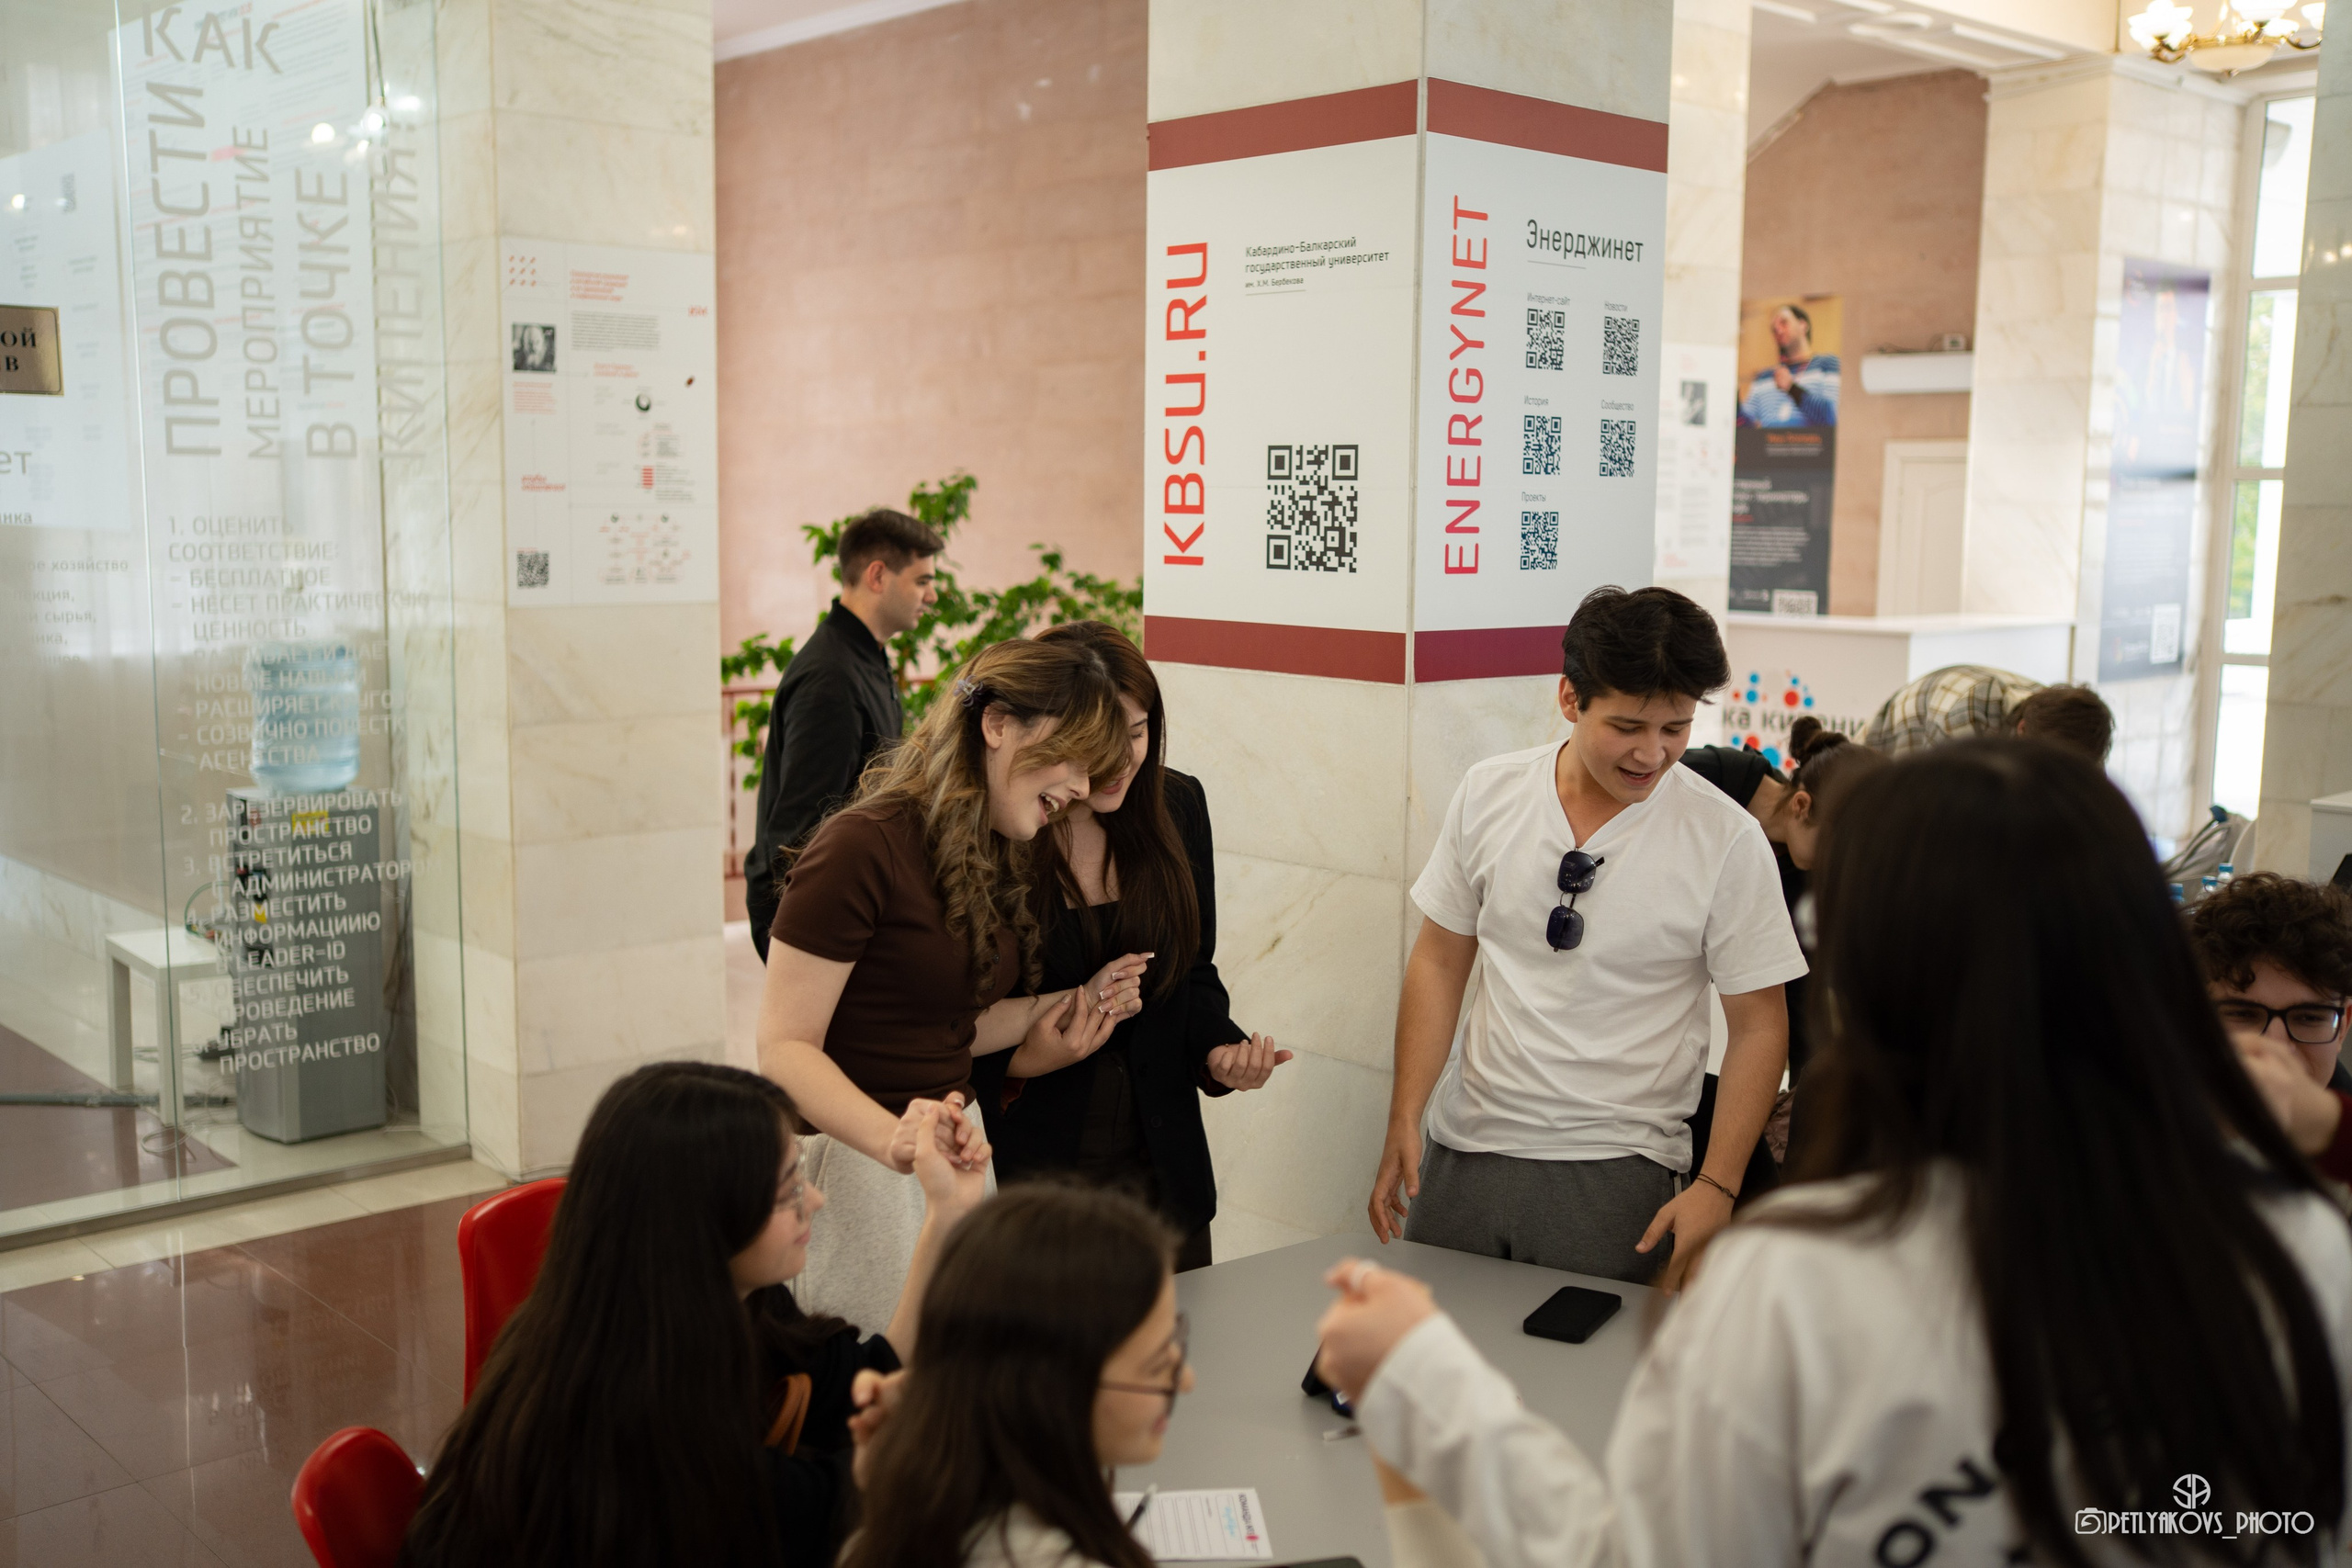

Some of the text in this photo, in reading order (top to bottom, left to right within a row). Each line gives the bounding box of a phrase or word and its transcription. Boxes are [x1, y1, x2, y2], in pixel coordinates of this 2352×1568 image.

[141, 3, 283, 74] КАК
[1245, 236, 1357, 257] Кабардино-Балкарский
[1526, 219, 1644, 262] Энерджинет
[145, 81, 222, 457] ПРОВЕСТИ
[1245, 251, 1389, 275] государственный университет
[232, 125, 282, 459] МЕРОПРИЯТИЕ
[294, 166, 356, 396] ТОЧКЕ
[1272, 277, 1304, 287] Бербекова
[1527, 292, 1570, 306] Интернет-сайт
[1604, 300, 1628, 312] Новости
[1444, 195, 1488, 574] ENERGYNET
[1163, 242, 1208, 566] KBSU.RU
[1523, 395, 1549, 408] История
[1600, 400, 1634, 412] Сообщество
[306, 421, 358, 459] В
[1521, 491, 1546, 503] Проекты
[192, 514, 294, 538] ОЦЕНИТЬ
[51, 555, 129, 572] хозяйство
[189, 566, 331, 589] БЕСПЛАТНОЕ
[190, 594, 258, 615] НЕСЕТ
[193, 617, 307, 642] ЦЕННОСТЬ
[197, 719, 308, 746] СОЗВЧНО
[198, 743, 320, 772] АГЕНСТВА
[206, 788, 403, 824] ЗАРЕЗЕРВИРОВАТЬ
[209, 814, 372, 848] ПРОСТРАНСТВО
[209, 840, 353, 874] ВСТРЕТИТЬСЯ
[219, 987, 356, 1022] РОВЕДЕНИЕ
[220, 1032, 381, 1075] ПРОСТРАНСТВО
